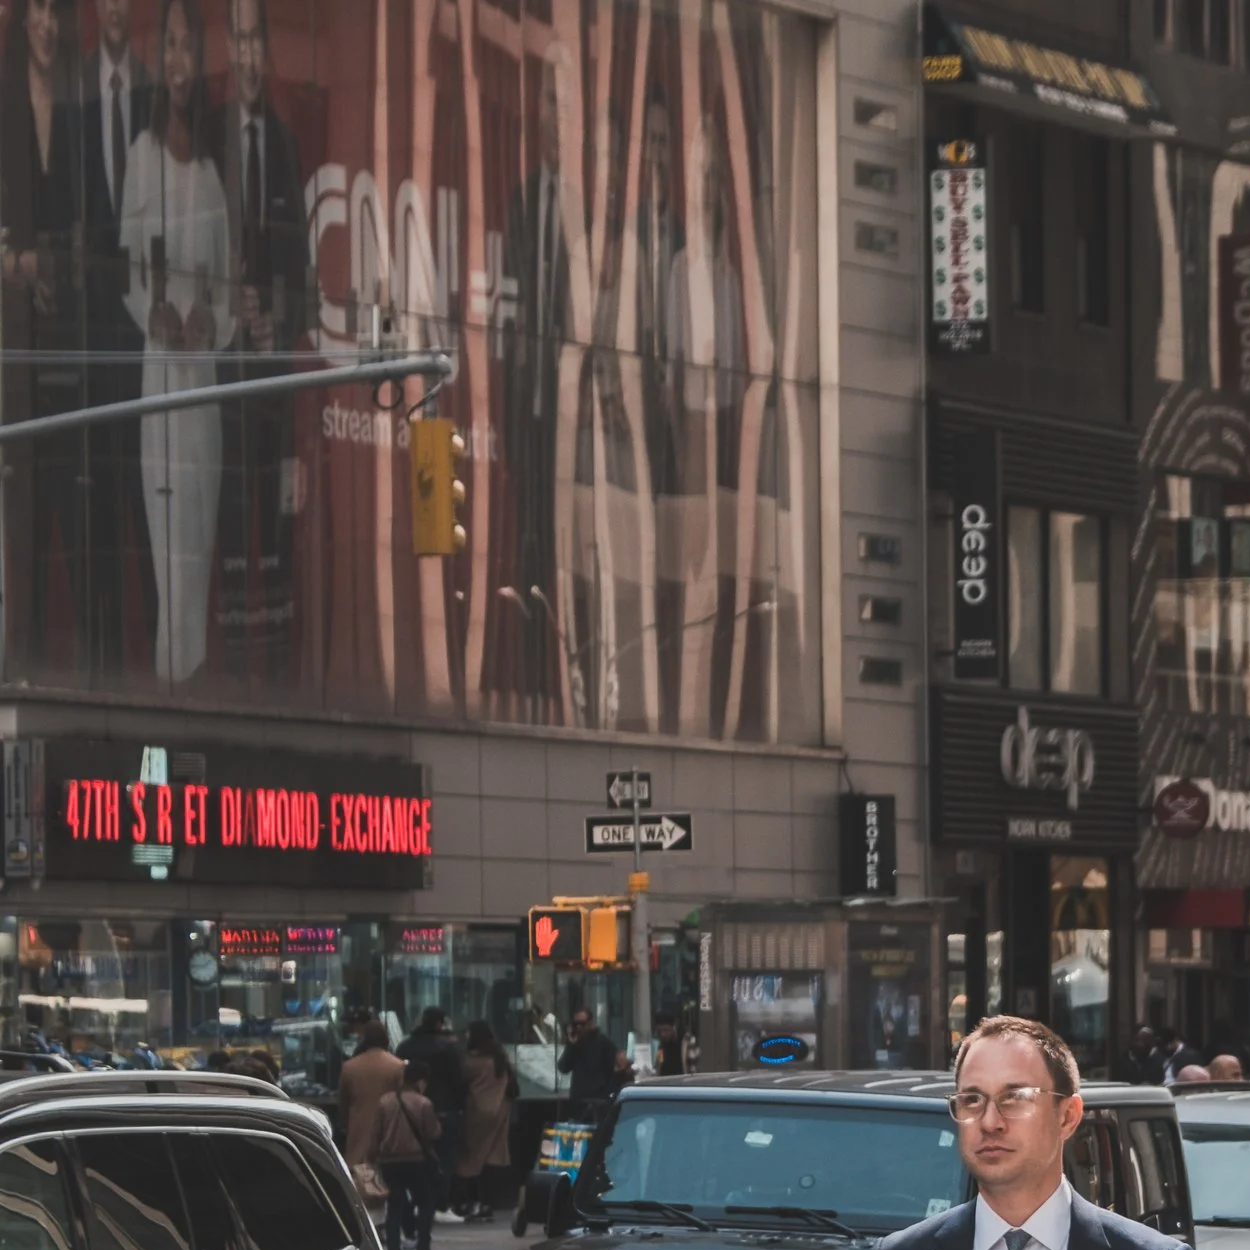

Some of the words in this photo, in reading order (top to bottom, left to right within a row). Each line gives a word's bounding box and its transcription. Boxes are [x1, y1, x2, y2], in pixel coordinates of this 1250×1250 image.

[322, 399, 392, 448] stream
[958, 504, 992, 605] deep
[66, 778, 119, 841] 47TH
[330, 793, 432, 856] EXCHANGE
[601, 826, 632, 841] ONE
[644, 826, 676, 841] WAY
